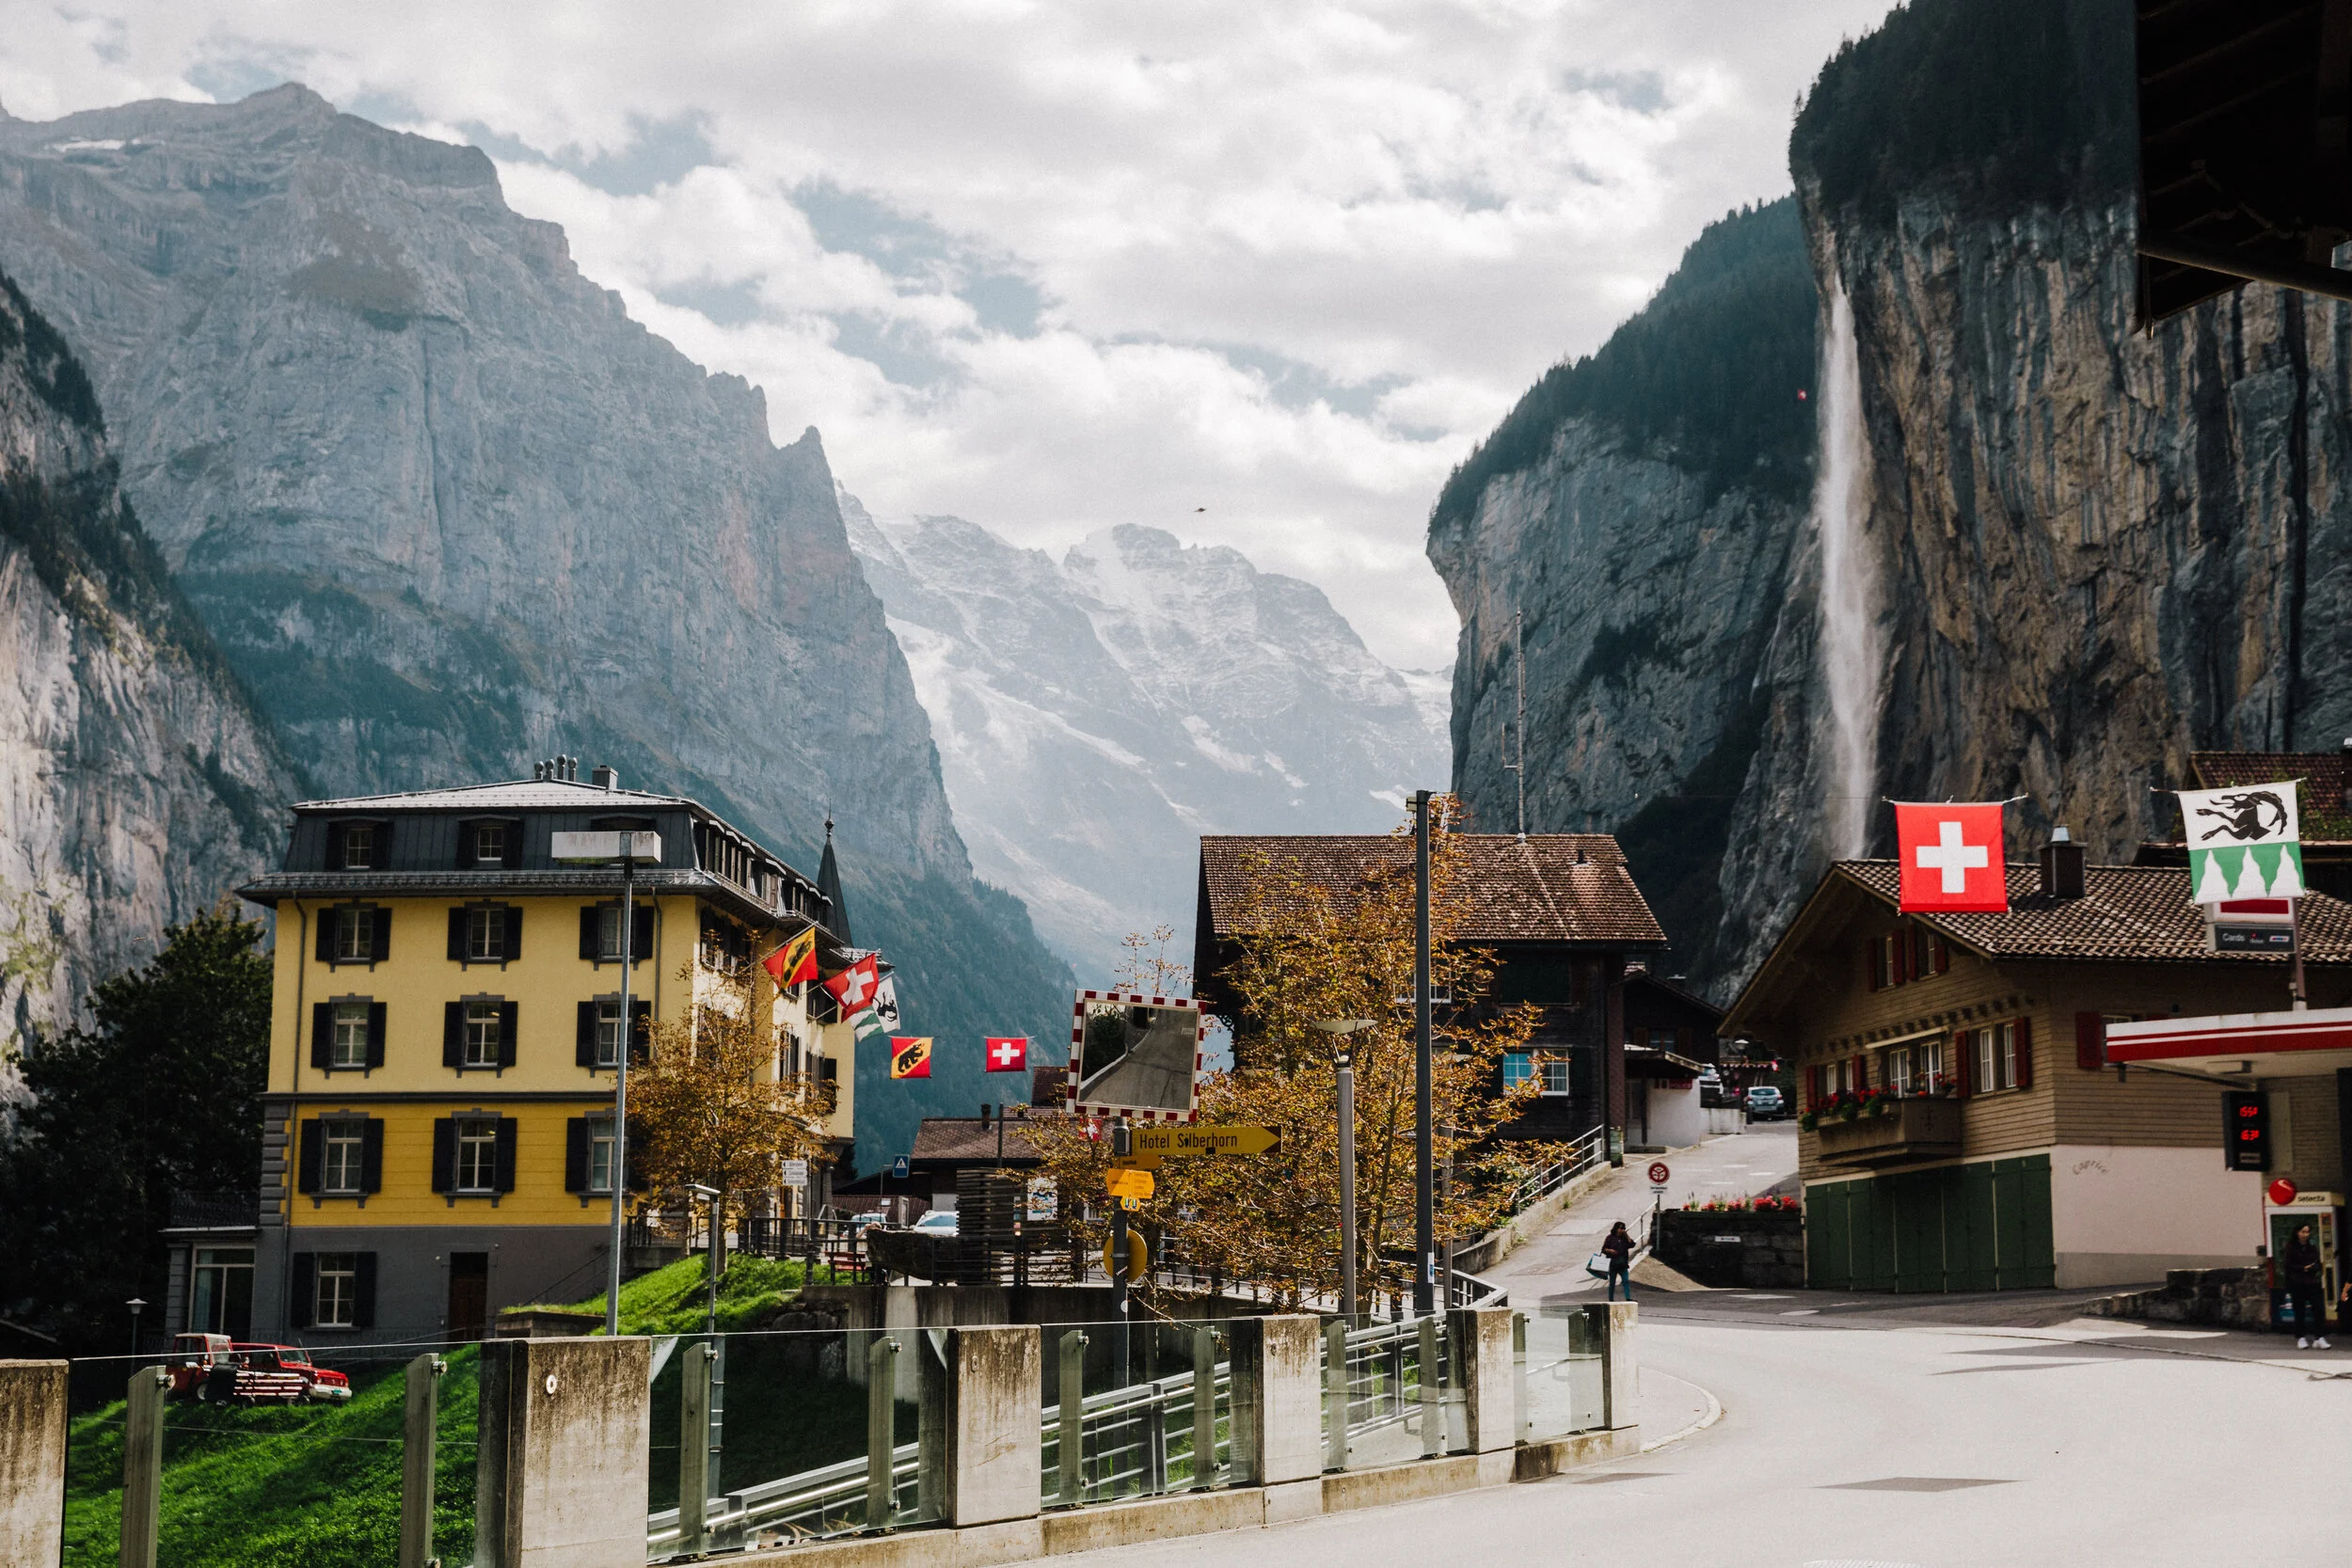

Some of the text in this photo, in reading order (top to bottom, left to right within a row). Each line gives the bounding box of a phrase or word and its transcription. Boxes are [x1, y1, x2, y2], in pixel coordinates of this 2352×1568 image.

[2222, 932, 2245, 942] Cards
[1139, 1132, 1238, 1148] Hotel Silberhorn
